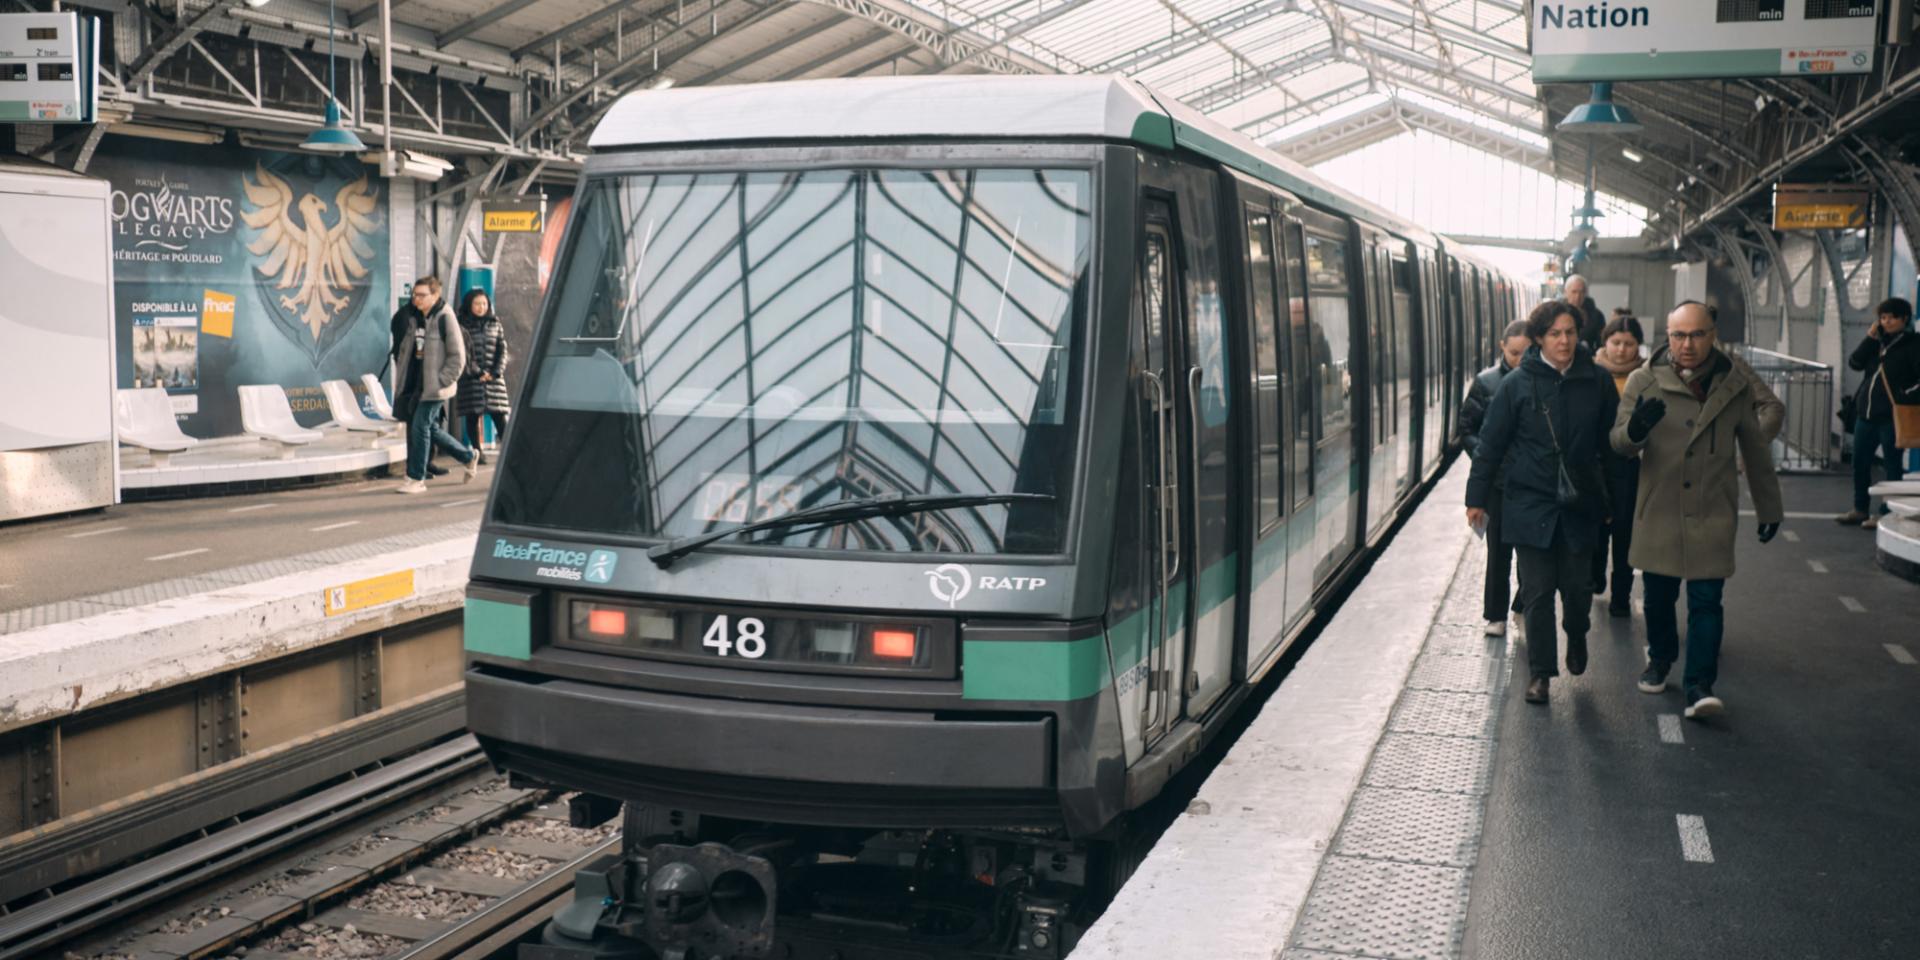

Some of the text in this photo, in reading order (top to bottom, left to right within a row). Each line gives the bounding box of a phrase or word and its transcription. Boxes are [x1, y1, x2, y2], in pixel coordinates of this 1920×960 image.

[1541, 2, 1649, 29] Nation
[1759, 9, 1783, 20] min
[1849, 5, 1873, 17] min
[59, 71, 72, 80] min
[110, 190, 234, 234] OGWARTS
[488, 216, 526, 227] Alarme
[119, 222, 207, 239] LEGACY
[172, 252, 222, 264] POUDLARD
[132, 300, 198, 312] DISPONIBLE À LA
[204, 298, 235, 313] fnac
[536, 566, 583, 581] mobilités
[978, 576, 1047, 591] RATP
[702, 614, 767, 659] 48
